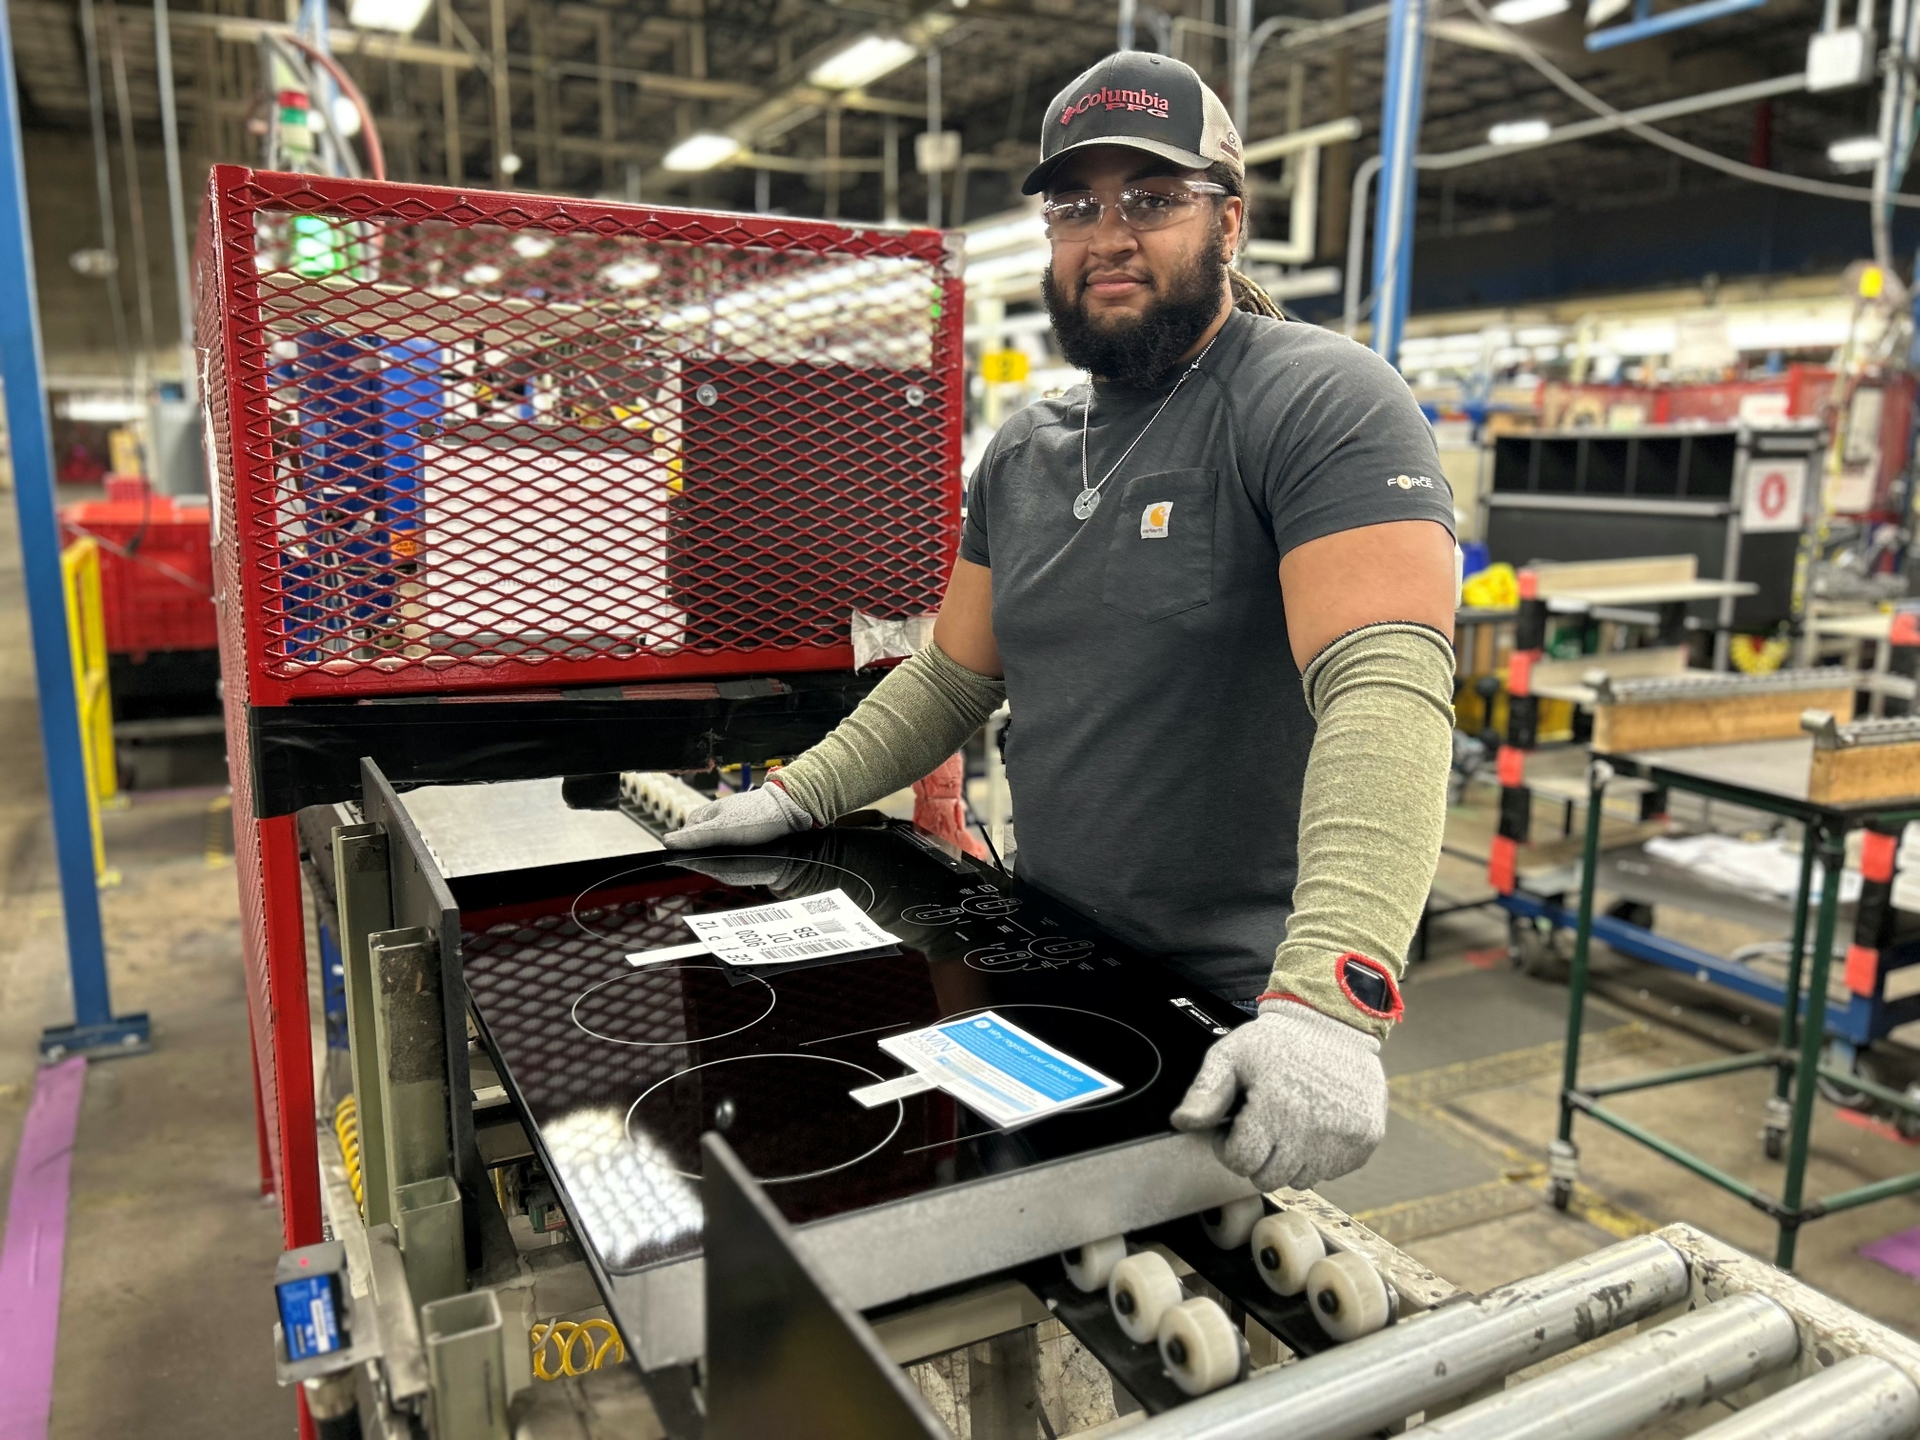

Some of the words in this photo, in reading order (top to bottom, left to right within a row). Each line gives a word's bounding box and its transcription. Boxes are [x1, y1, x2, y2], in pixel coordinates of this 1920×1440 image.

[1075, 86, 1169, 114] Columbia
[1105, 102, 1169, 119] PFG
[1387, 474, 1434, 490] FORCE
[696, 920, 719, 930] 12
[793, 926, 819, 939] BB
[735, 929, 767, 947] 9030
[766, 932, 794, 944] DT
[726, 953, 754, 963] GE
[903, 1035, 938, 1056] $2500
[919, 1030, 957, 1053] WIN
[987, 1027, 1004, 1040] Why
[1002, 1038, 1032, 1056] register
[1026, 1053, 1049, 1065] your
[1044, 1063, 1084, 1082] product?
